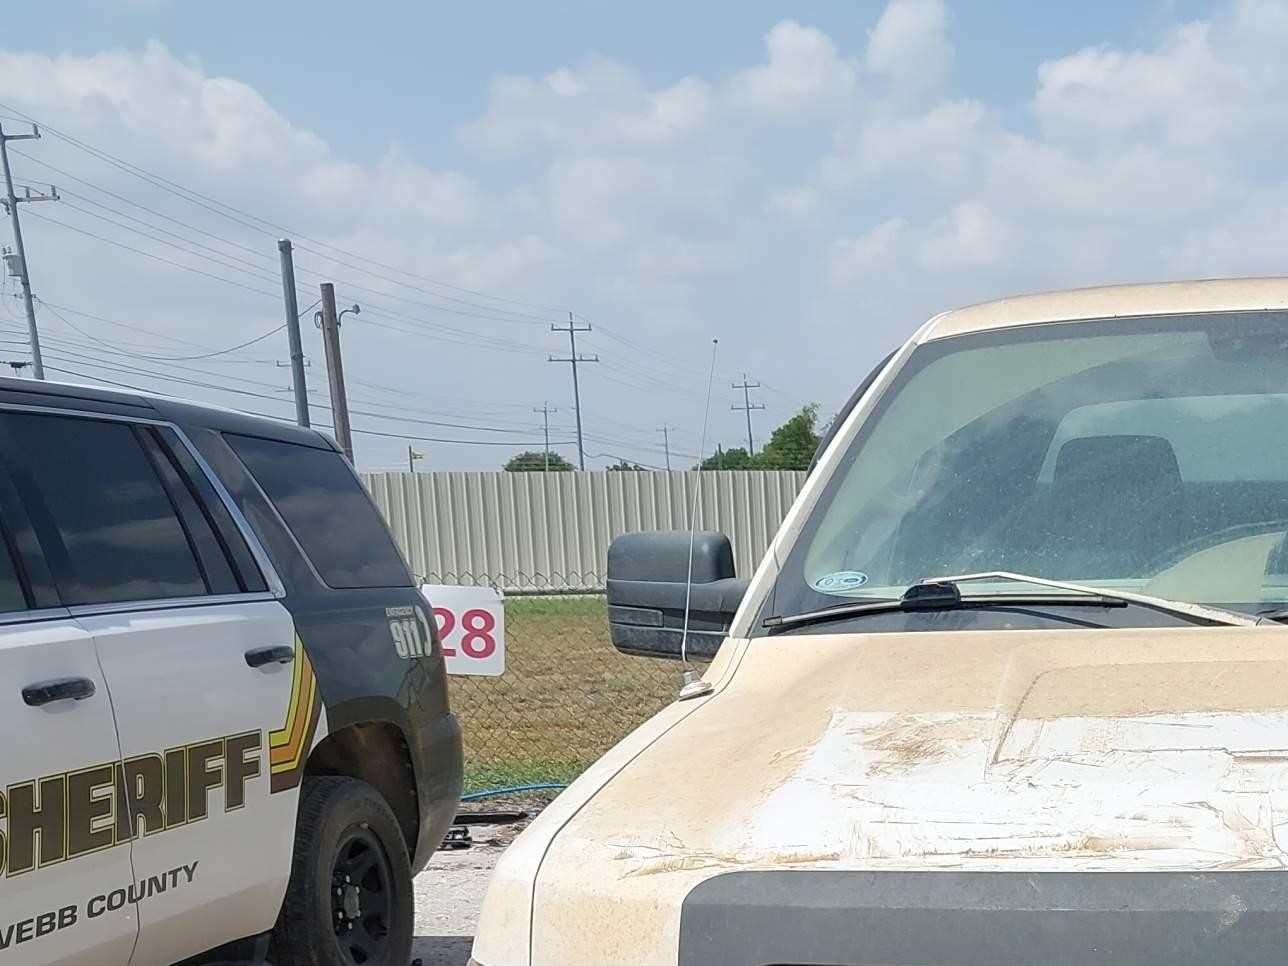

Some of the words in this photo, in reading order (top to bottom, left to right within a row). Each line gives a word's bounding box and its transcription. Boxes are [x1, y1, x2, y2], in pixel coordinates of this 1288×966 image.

[389, 618, 424, 660] 911
[0, 728, 263, 879] HERIFF
[87, 860, 199, 919] COUNTY
